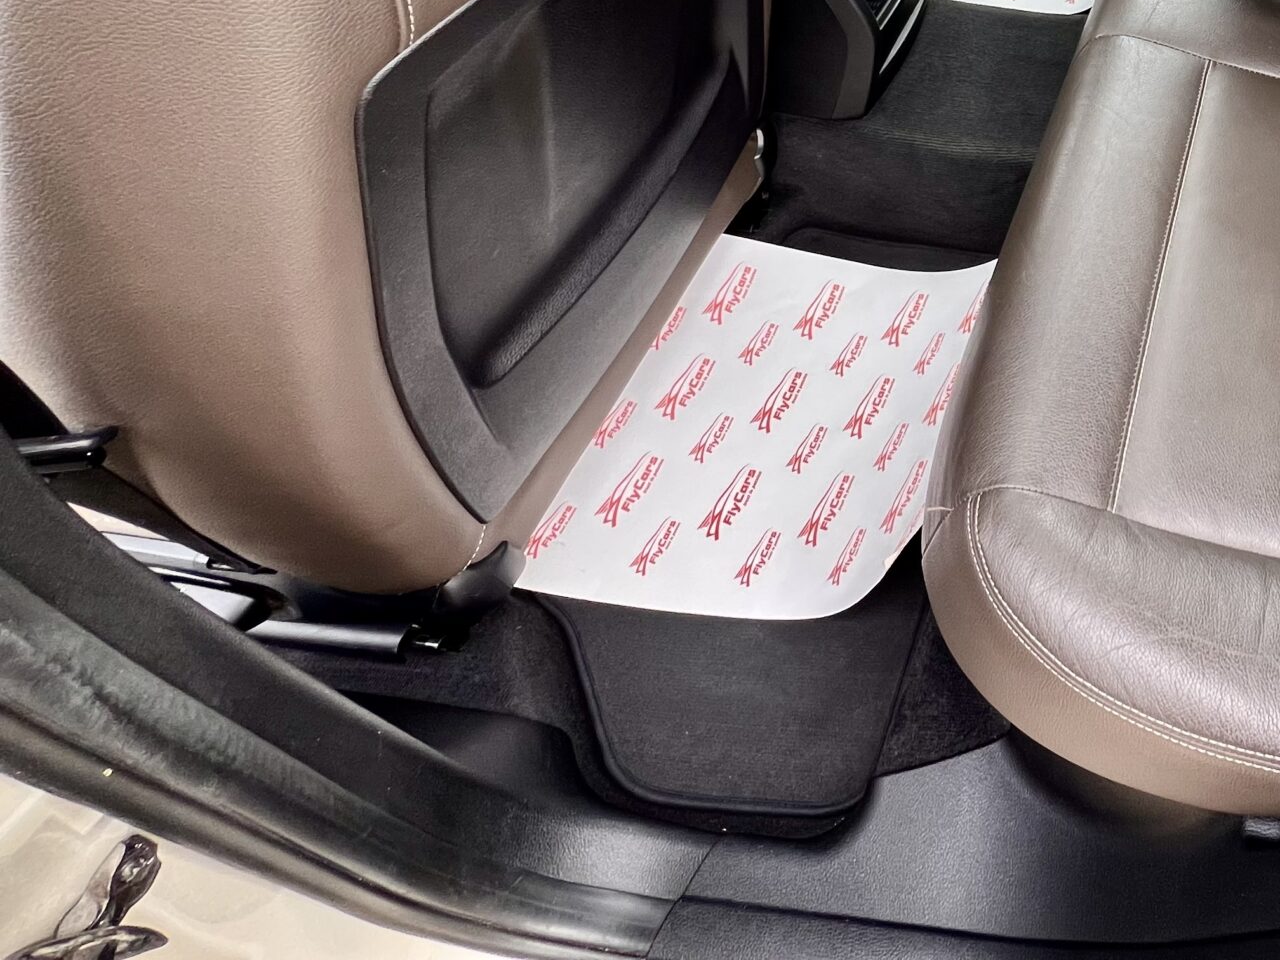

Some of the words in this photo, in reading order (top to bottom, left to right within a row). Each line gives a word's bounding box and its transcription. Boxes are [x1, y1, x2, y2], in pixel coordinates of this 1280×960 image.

[724, 266, 752, 313] FlyCars
[814, 284, 840, 329] FlyCars
[661, 306, 683, 342] FlyCars
[901, 293, 924, 336] FlyCars
[754, 323, 775, 357] FlyCars
[845, 335, 865, 368] FlyCars
[679, 357, 710, 407] FlyCars
[773, 371, 803, 420] FlyCars
[864, 377, 890, 426] FlyCars
[607, 400, 633, 439] FlyCars
[706, 415, 730, 454] FlyCars
[887, 423, 906, 461] FlyCars
[802, 426, 824, 464] FlyCars
[621, 456, 659, 512] FlyCars
[723, 469, 757, 526] FlyCars
[820, 475, 850, 531] FlyCars
[897, 460, 925, 517] FlyCars
[541, 505, 573, 548] FlyCars
[649, 520, 676, 565] FlyCars
[752, 531, 777, 575] FlyCars
[842, 528, 864, 573] FlyCars
